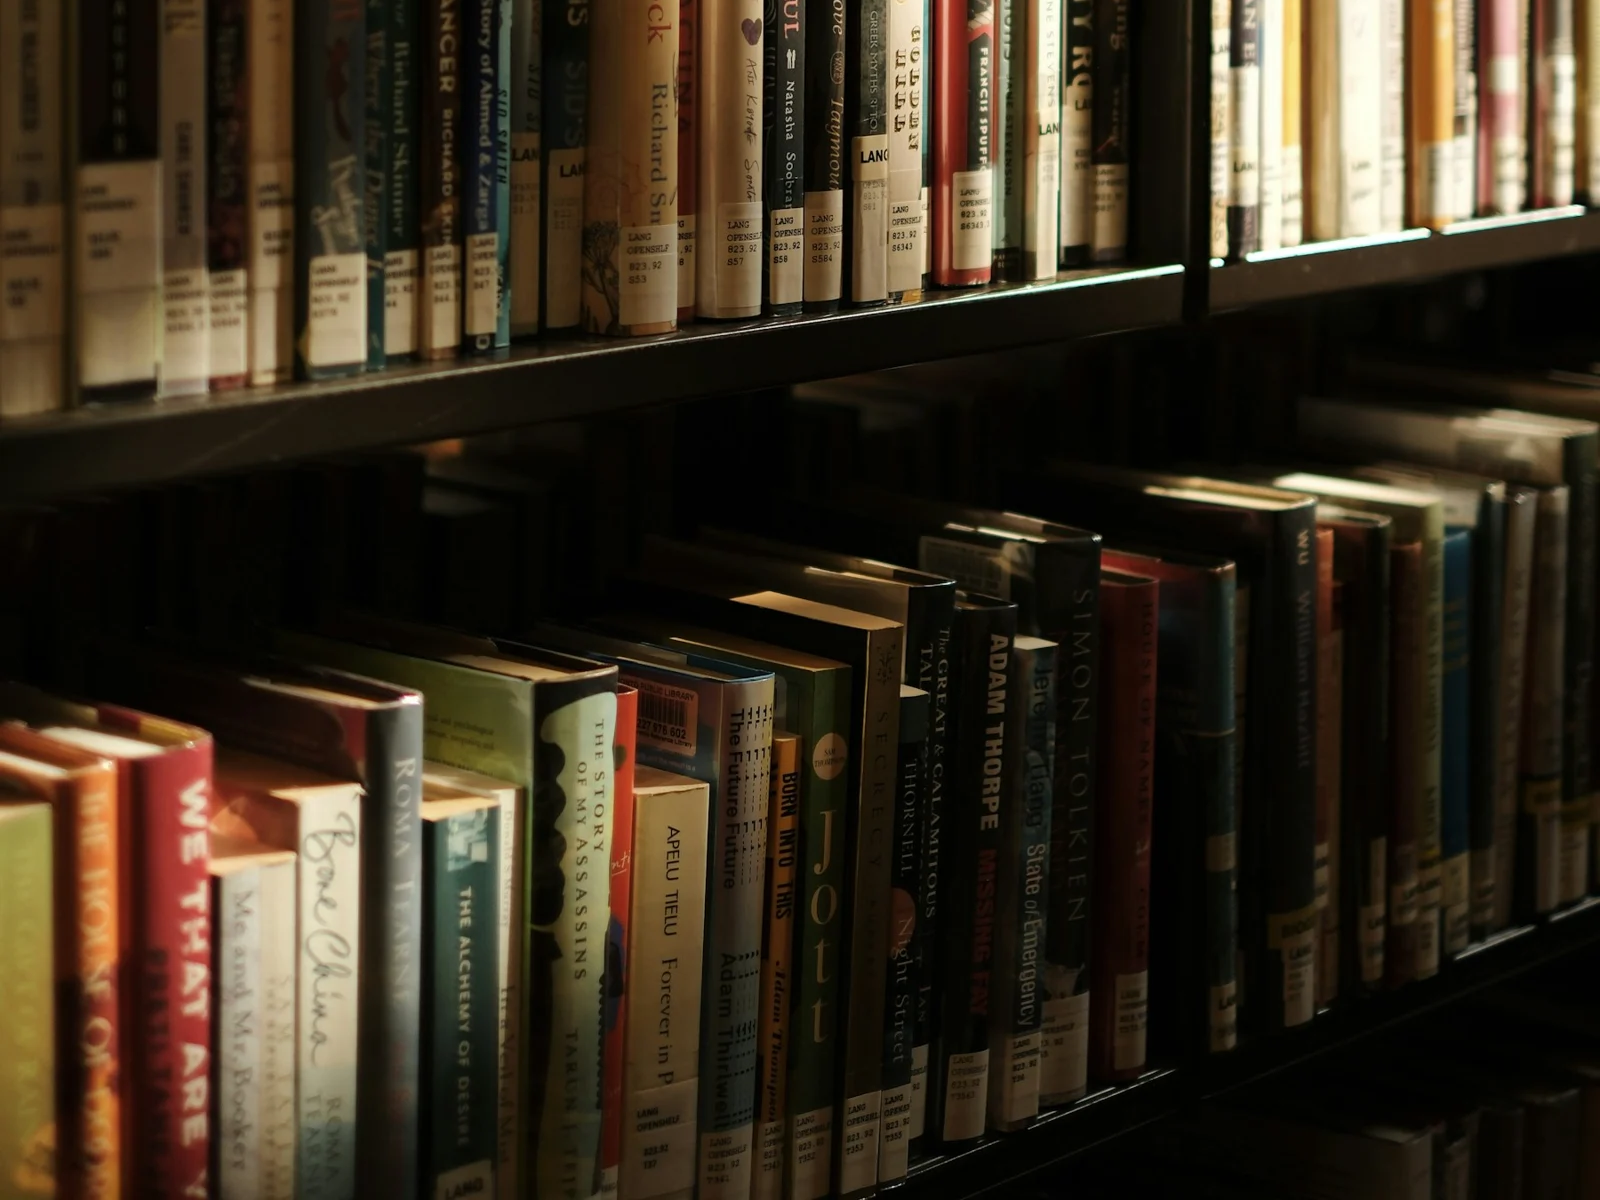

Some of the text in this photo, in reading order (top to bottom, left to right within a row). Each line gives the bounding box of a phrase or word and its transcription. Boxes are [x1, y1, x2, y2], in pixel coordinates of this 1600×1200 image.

[869, 9, 879, 50] GREEK
[479, 58, 494, 81] of
[869, 52, 879, 95] MYTHS
[978, 47, 989, 114] FRANCIS
[391, 42, 411, 238] Richard Skinner
[478, 81, 494, 149] Ahmed
[651, 83, 669, 183] Richard
[783, 79, 796, 141] Natasha
[441, 107, 455, 197] RICHARD
[478, 152, 493, 169] &
[473, 174, 493, 233] Zarga
[727, 220, 750, 231] LANG
[811, 214, 835, 225] LANG
[727, 244, 758, 255] 823.92
[727, 257, 744, 267] S57
[772, 255, 788, 265] S58
[811, 241, 841, 252] 823.92
[811, 254, 833, 265] S584
[892, 242, 914, 253] S6343
[663, 687, 695, 702] LIBRARY
[593, 718, 606, 853] THE STORY
[870, 710, 889, 870] SECRECY
[926, 626, 951, 919] The GREAT & CALAMITOUS
[1067, 587, 1093, 924] SIMON TOLKIEN
[775, 771, 799, 921] BORN INTO THIS
[969, 633, 1010, 1017] ADAM THORPE MISSING FAY
[575, 760, 589, 981] OF MY ASSASSINS
[1024, 842, 1047, 895] State
[302, 810, 356, 1068] Bone China
[657, 826, 681, 1065] APELU TIELU Forever in
[713, 708, 745, 1132] The Future Future Adam Thirlwell
[890, 756, 918, 1064] THORNELL Night Street
[178, 776, 211, 1148] WE THAT ARE
[1016, 918, 1044, 1028] Emergency
[455, 884, 473, 1147] THE ALCHEMY OF DESIRE
[564, 1029, 579, 1113] TARUN
